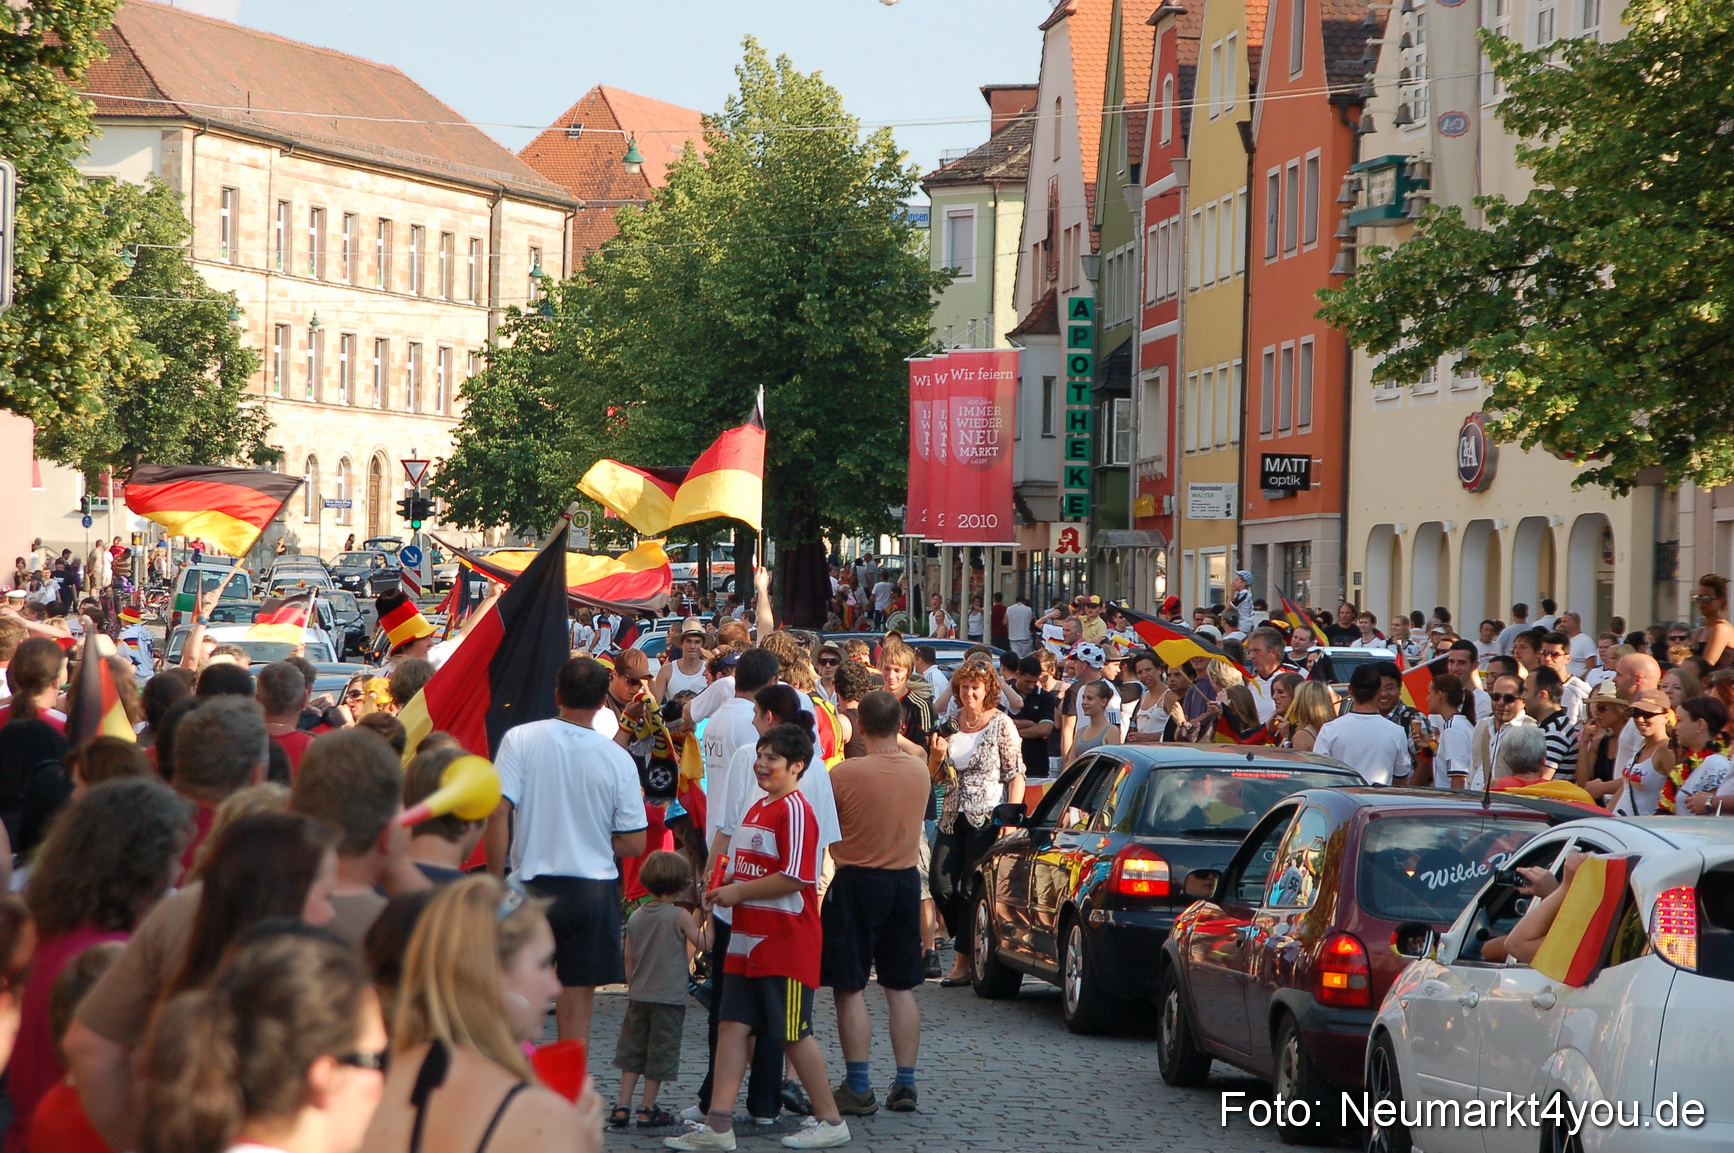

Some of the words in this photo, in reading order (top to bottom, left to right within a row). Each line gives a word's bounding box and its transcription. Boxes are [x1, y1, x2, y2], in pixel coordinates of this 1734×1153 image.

[950, 368, 975, 381] Wir
[978, 367, 1014, 380] feiern
[958, 406, 1002, 417] IMMER
[1069, 299, 1090, 515] APOTHEKE
[956, 417, 1003, 428] WIEDER
[959, 430, 1000, 445] NEU
[960, 447, 999, 457] MARKT
[1460, 435, 1479, 468] C&A
[1265, 457, 1309, 473] MATT
[1269, 475, 1301, 487] optik
[958, 513, 998, 528] 2010
[1420, 864, 1489, 890] Wilde
